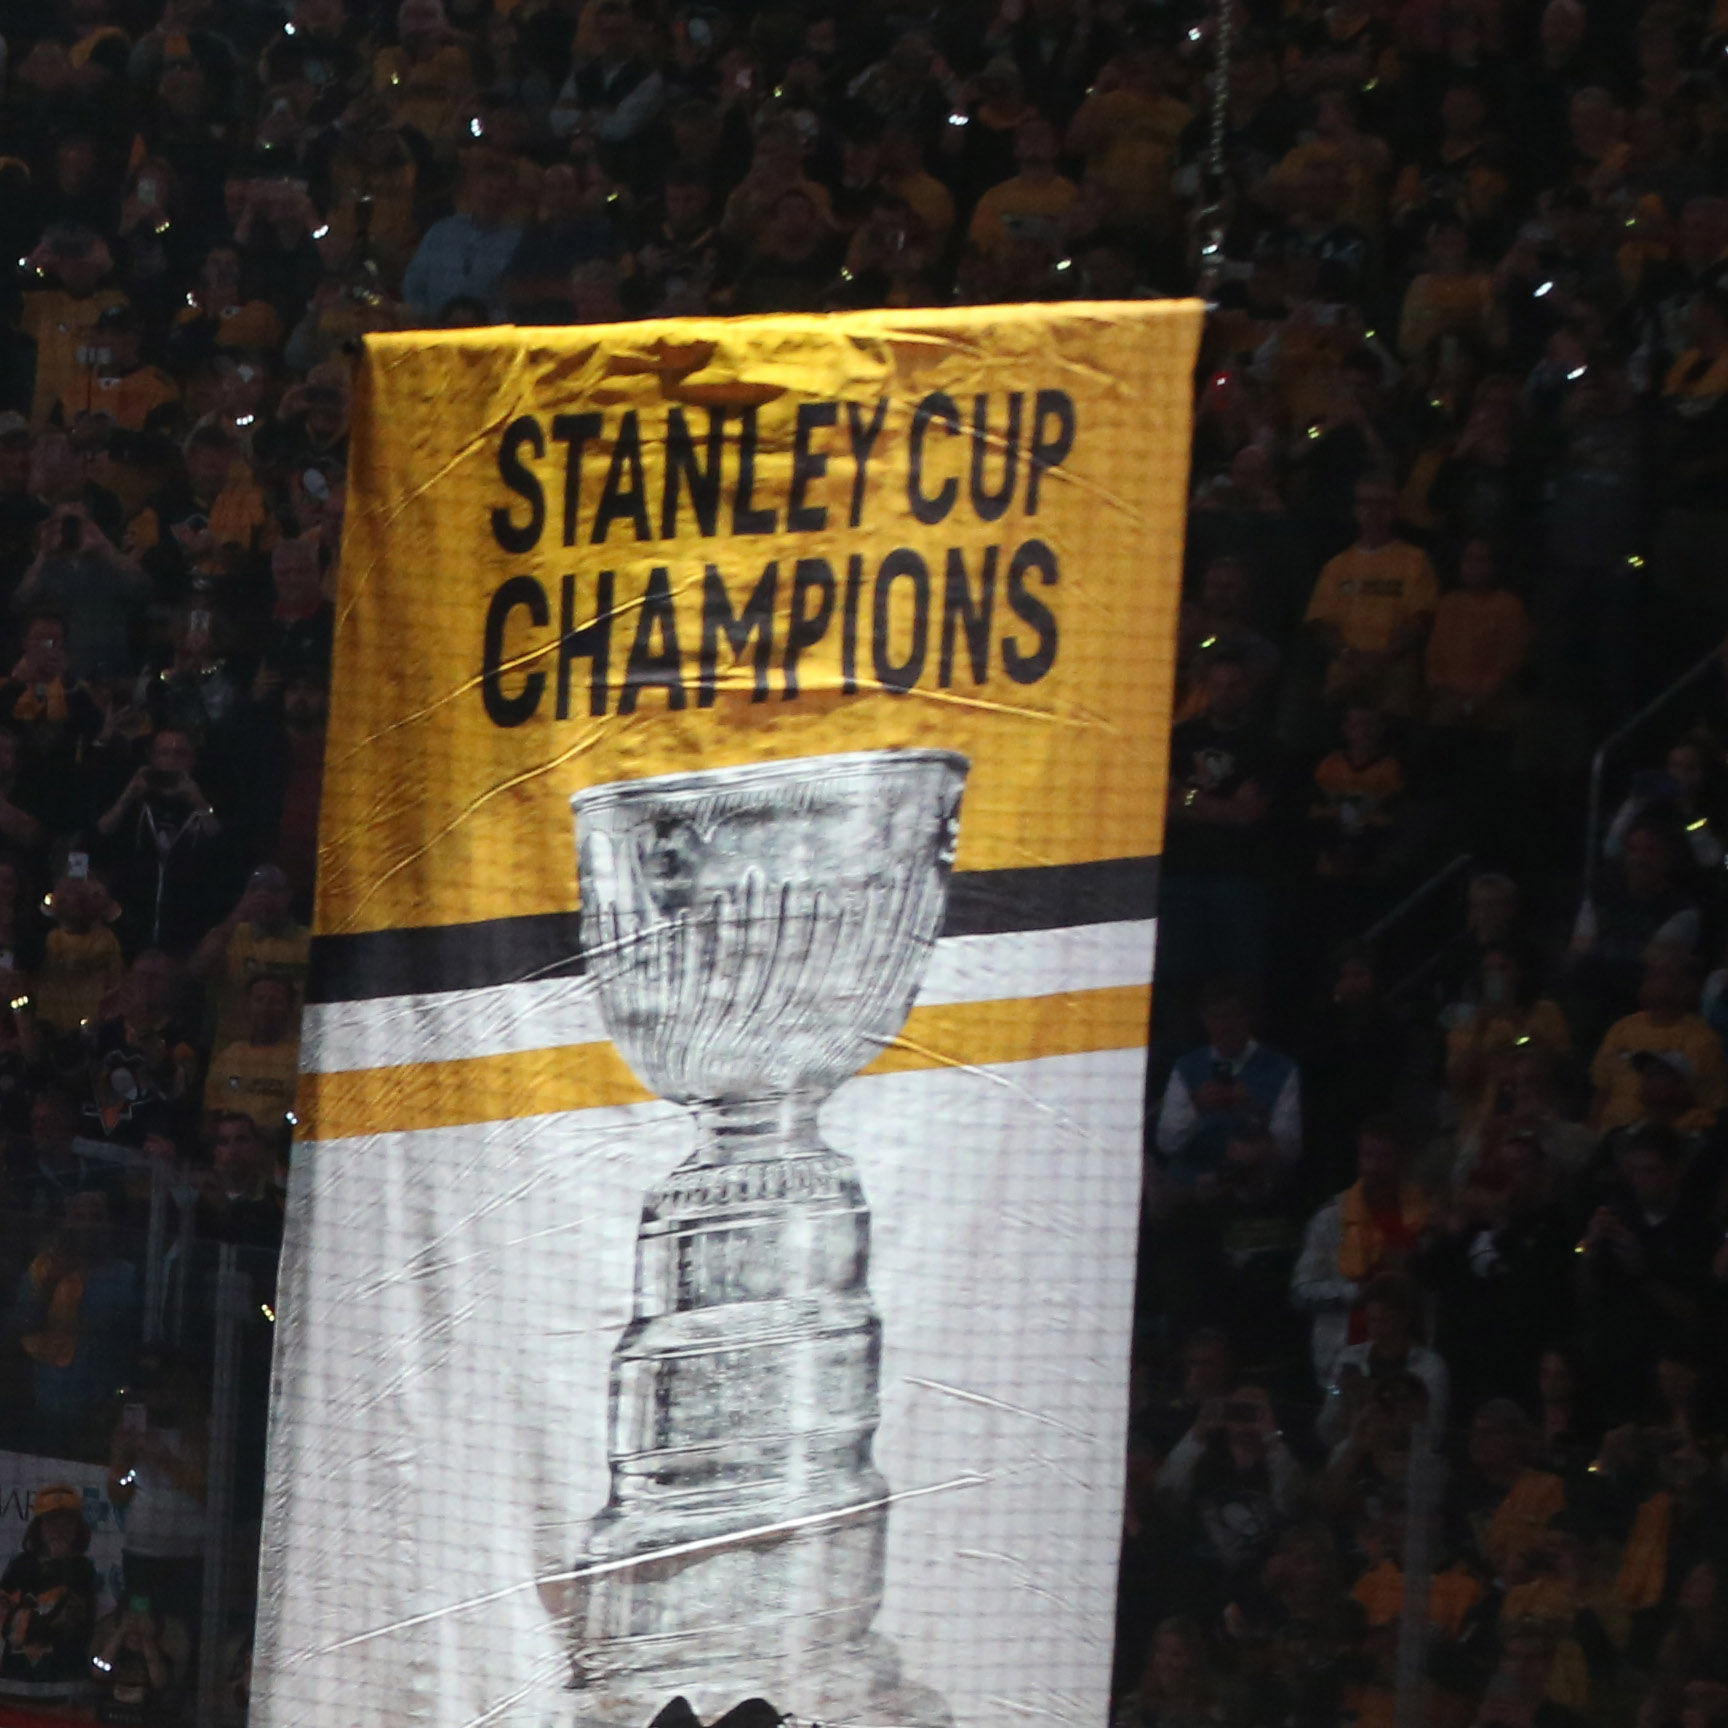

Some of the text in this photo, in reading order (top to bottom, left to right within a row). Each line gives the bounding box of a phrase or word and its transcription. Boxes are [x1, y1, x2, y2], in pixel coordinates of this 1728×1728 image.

[490, 389, 1075, 553] STANLEY CUP
[481, 539, 1060, 728] CHAMPIONS
